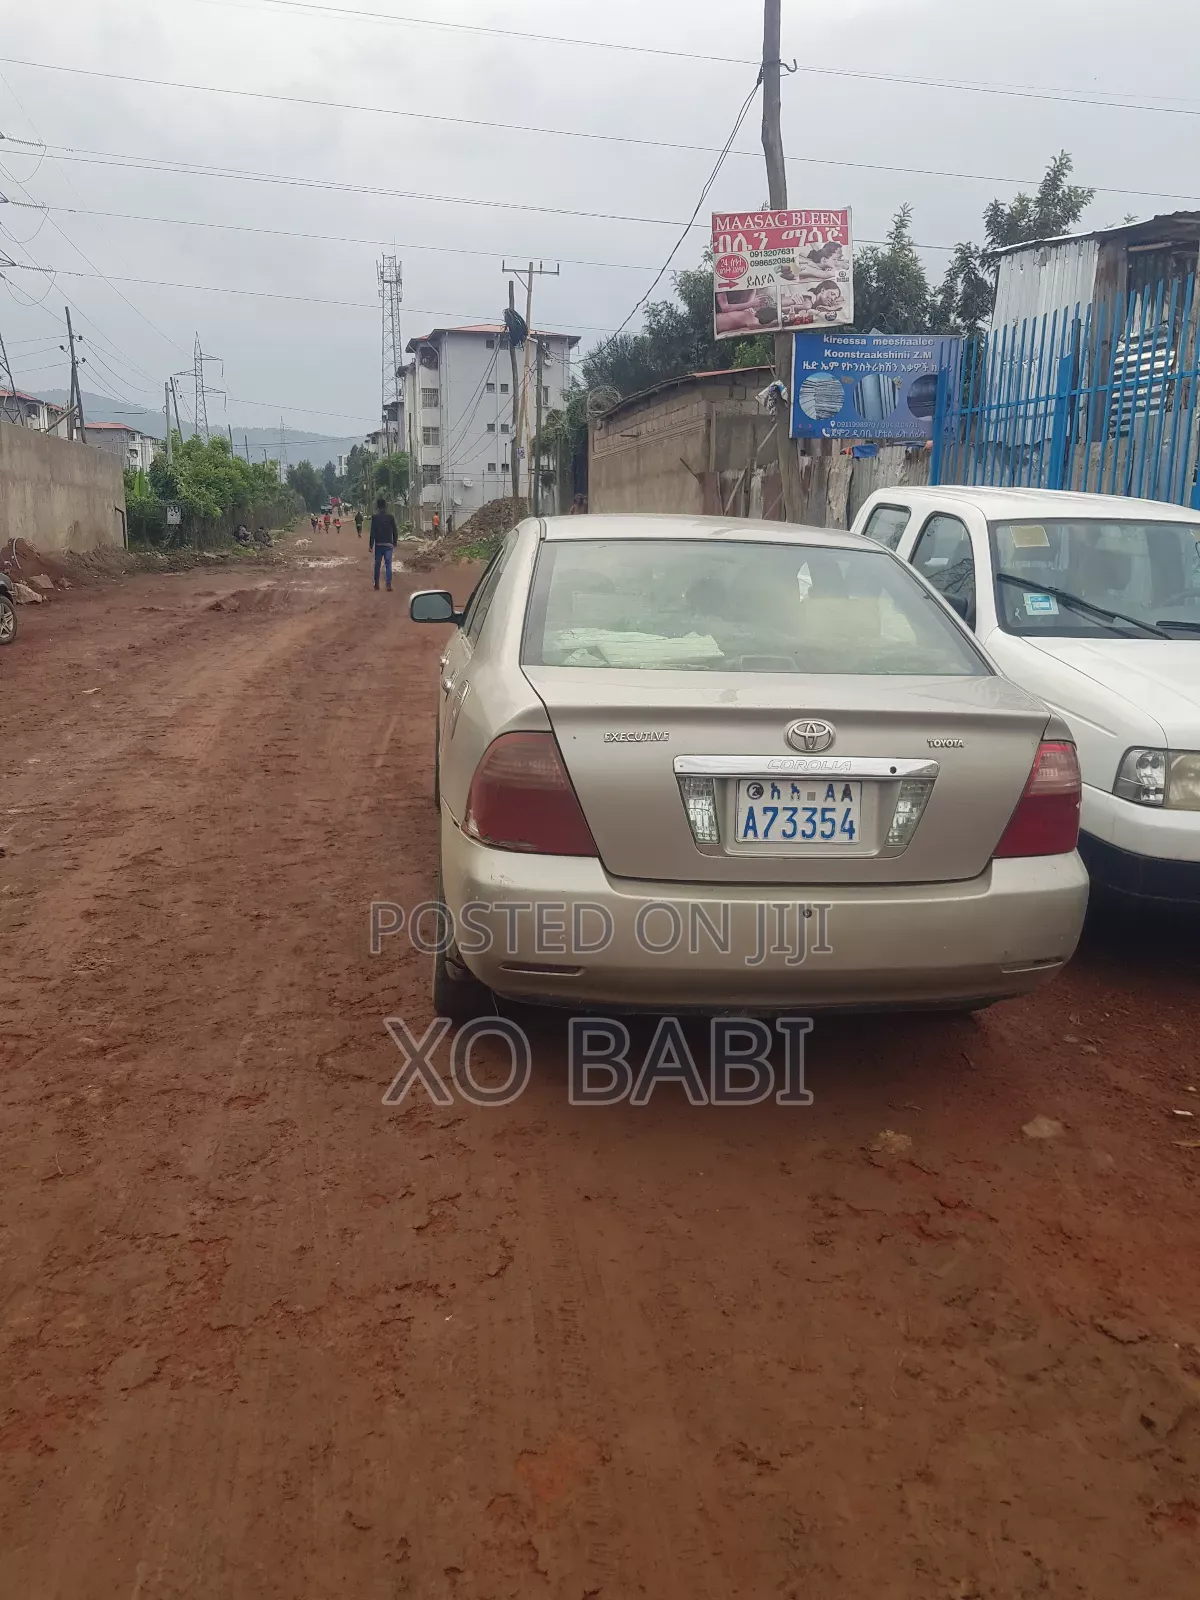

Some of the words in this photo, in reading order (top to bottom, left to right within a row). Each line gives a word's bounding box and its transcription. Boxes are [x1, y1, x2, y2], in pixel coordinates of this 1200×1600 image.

[715, 213, 788, 231] MAASAG
[791, 212, 843, 226] BLEEN
[749, 248, 795, 258] 0913207631
[824, 349, 910, 359] Koonstraakshinii
[913, 350, 933, 359] Z.M
[603, 731, 670, 742] EXECUTIVE
[927, 739, 964, 748] TOYOTA
[767, 759, 852, 771] COROLLA
[824, 784, 853, 802] AA
[742, 806, 856, 839] A73354
